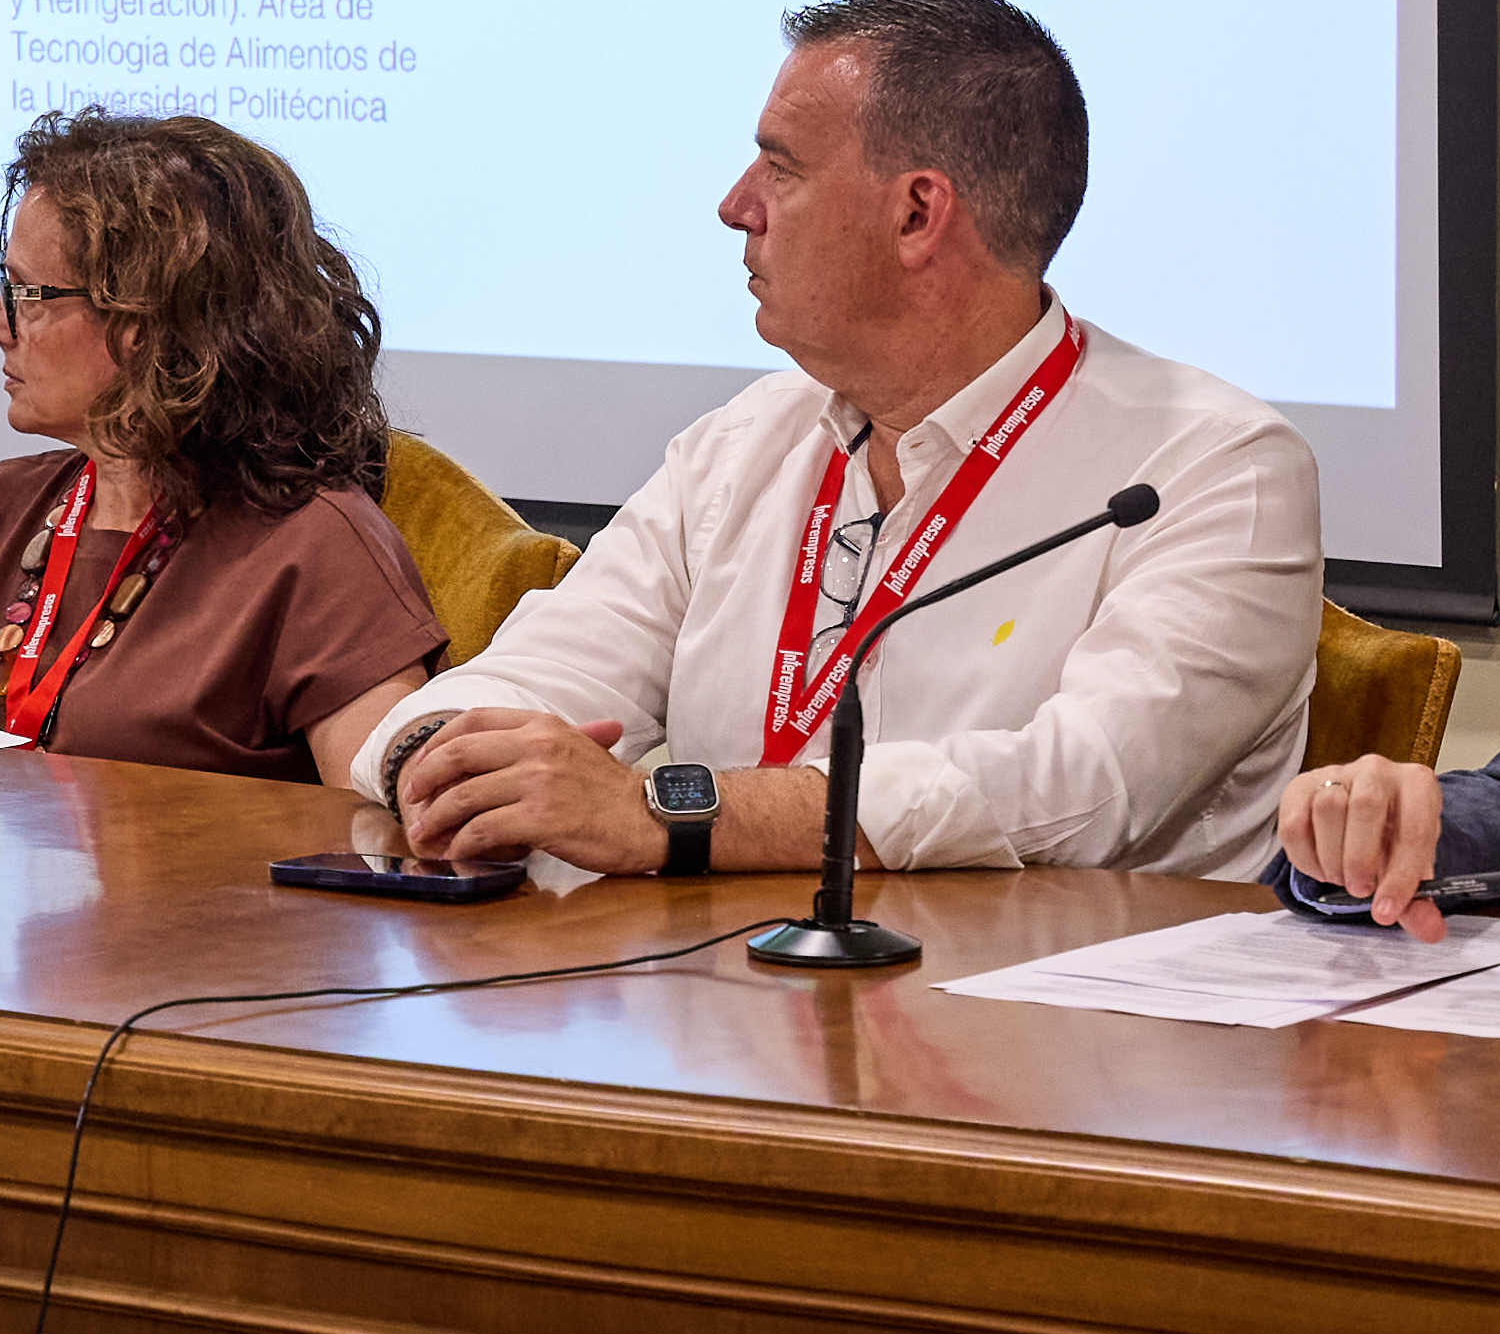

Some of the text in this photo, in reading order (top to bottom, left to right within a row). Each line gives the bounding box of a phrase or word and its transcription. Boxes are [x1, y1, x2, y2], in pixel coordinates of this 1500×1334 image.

[10, 30, 418, 74] Tecnología de Alimentos de
[11, 79, 36, 112] la
[228, 84, 388, 123] Politécnica
[979, 385, 1046, 461] Interempresas
[800, 504, 831, 585] Interempresas
[883, 514, 947, 598] Interempresas
[788, 653, 852, 737] Interempresas
